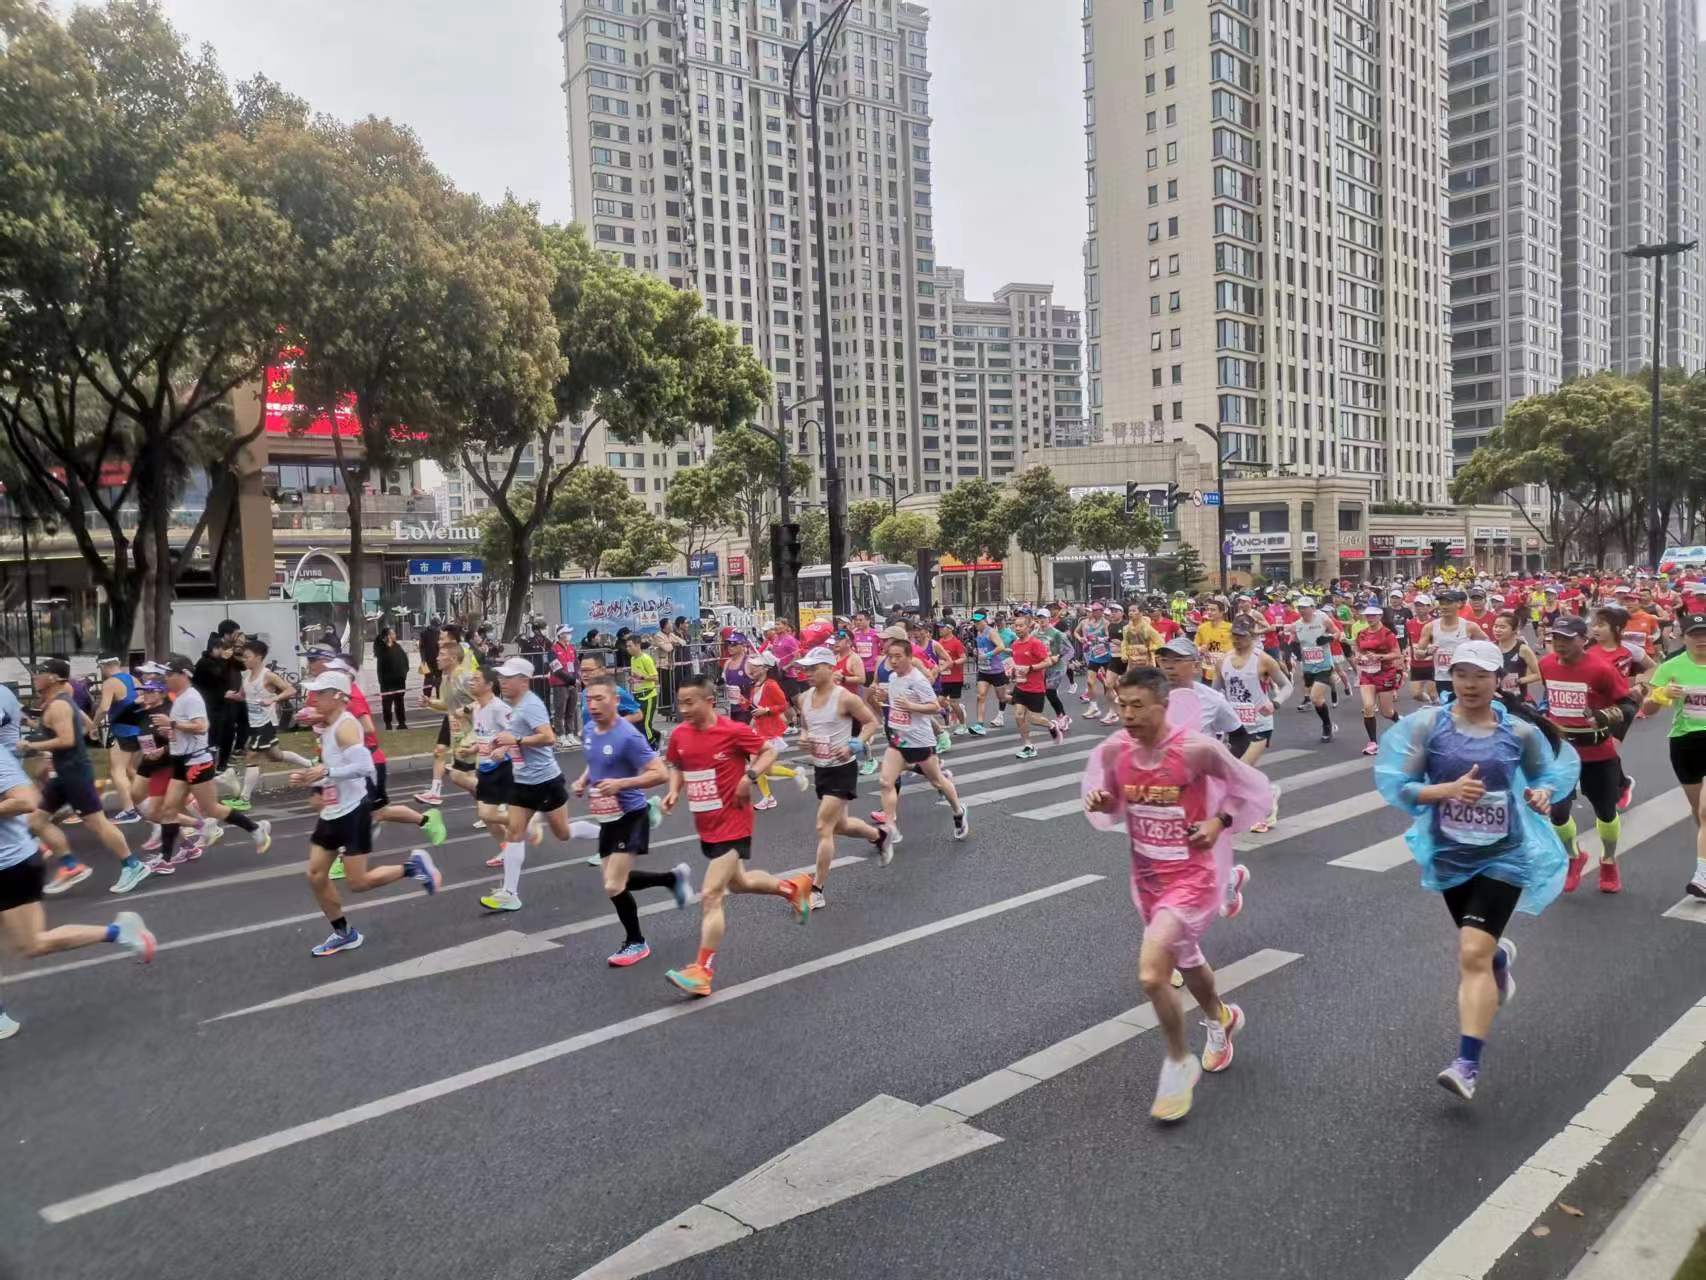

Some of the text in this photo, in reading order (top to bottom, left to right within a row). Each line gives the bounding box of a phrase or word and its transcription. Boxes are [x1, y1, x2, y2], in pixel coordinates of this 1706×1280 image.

[299, 569, 323, 577] LIVING
[419, 561, 472, 573] 市府路
[588, 596, 674, 618] 温州江心屿
[1548, 690, 1586, 704] A10628
[1442, 802, 1506, 826] A20369
